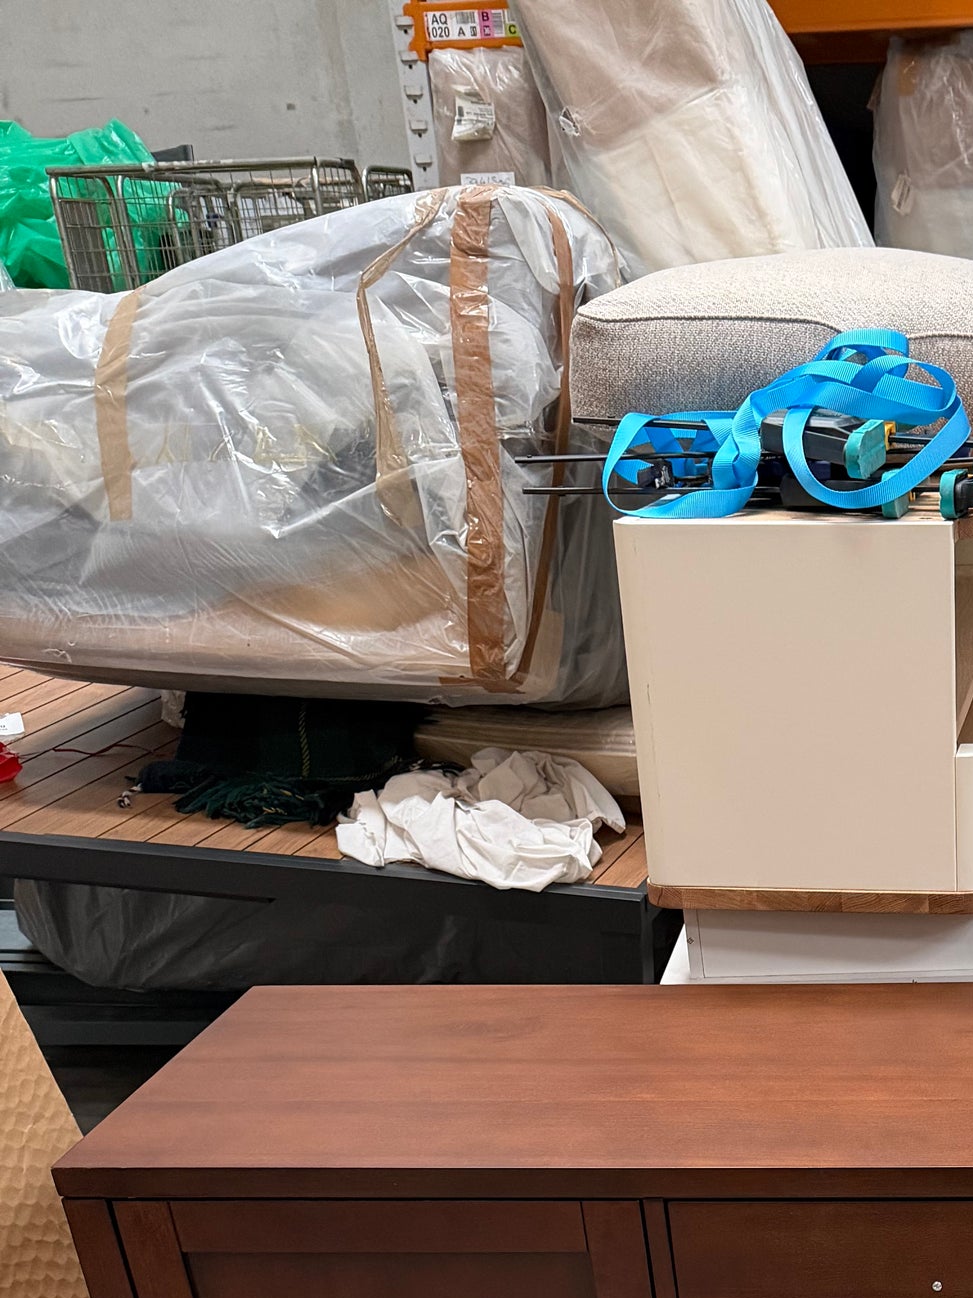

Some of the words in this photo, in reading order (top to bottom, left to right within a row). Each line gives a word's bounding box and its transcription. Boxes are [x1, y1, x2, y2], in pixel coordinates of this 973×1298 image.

[431, 13, 448, 25] AQ
[481, 11, 490, 21] B
[431, 26, 450, 38] 020
[457, 27, 466, 37] A
[508, 24, 516, 35] C
